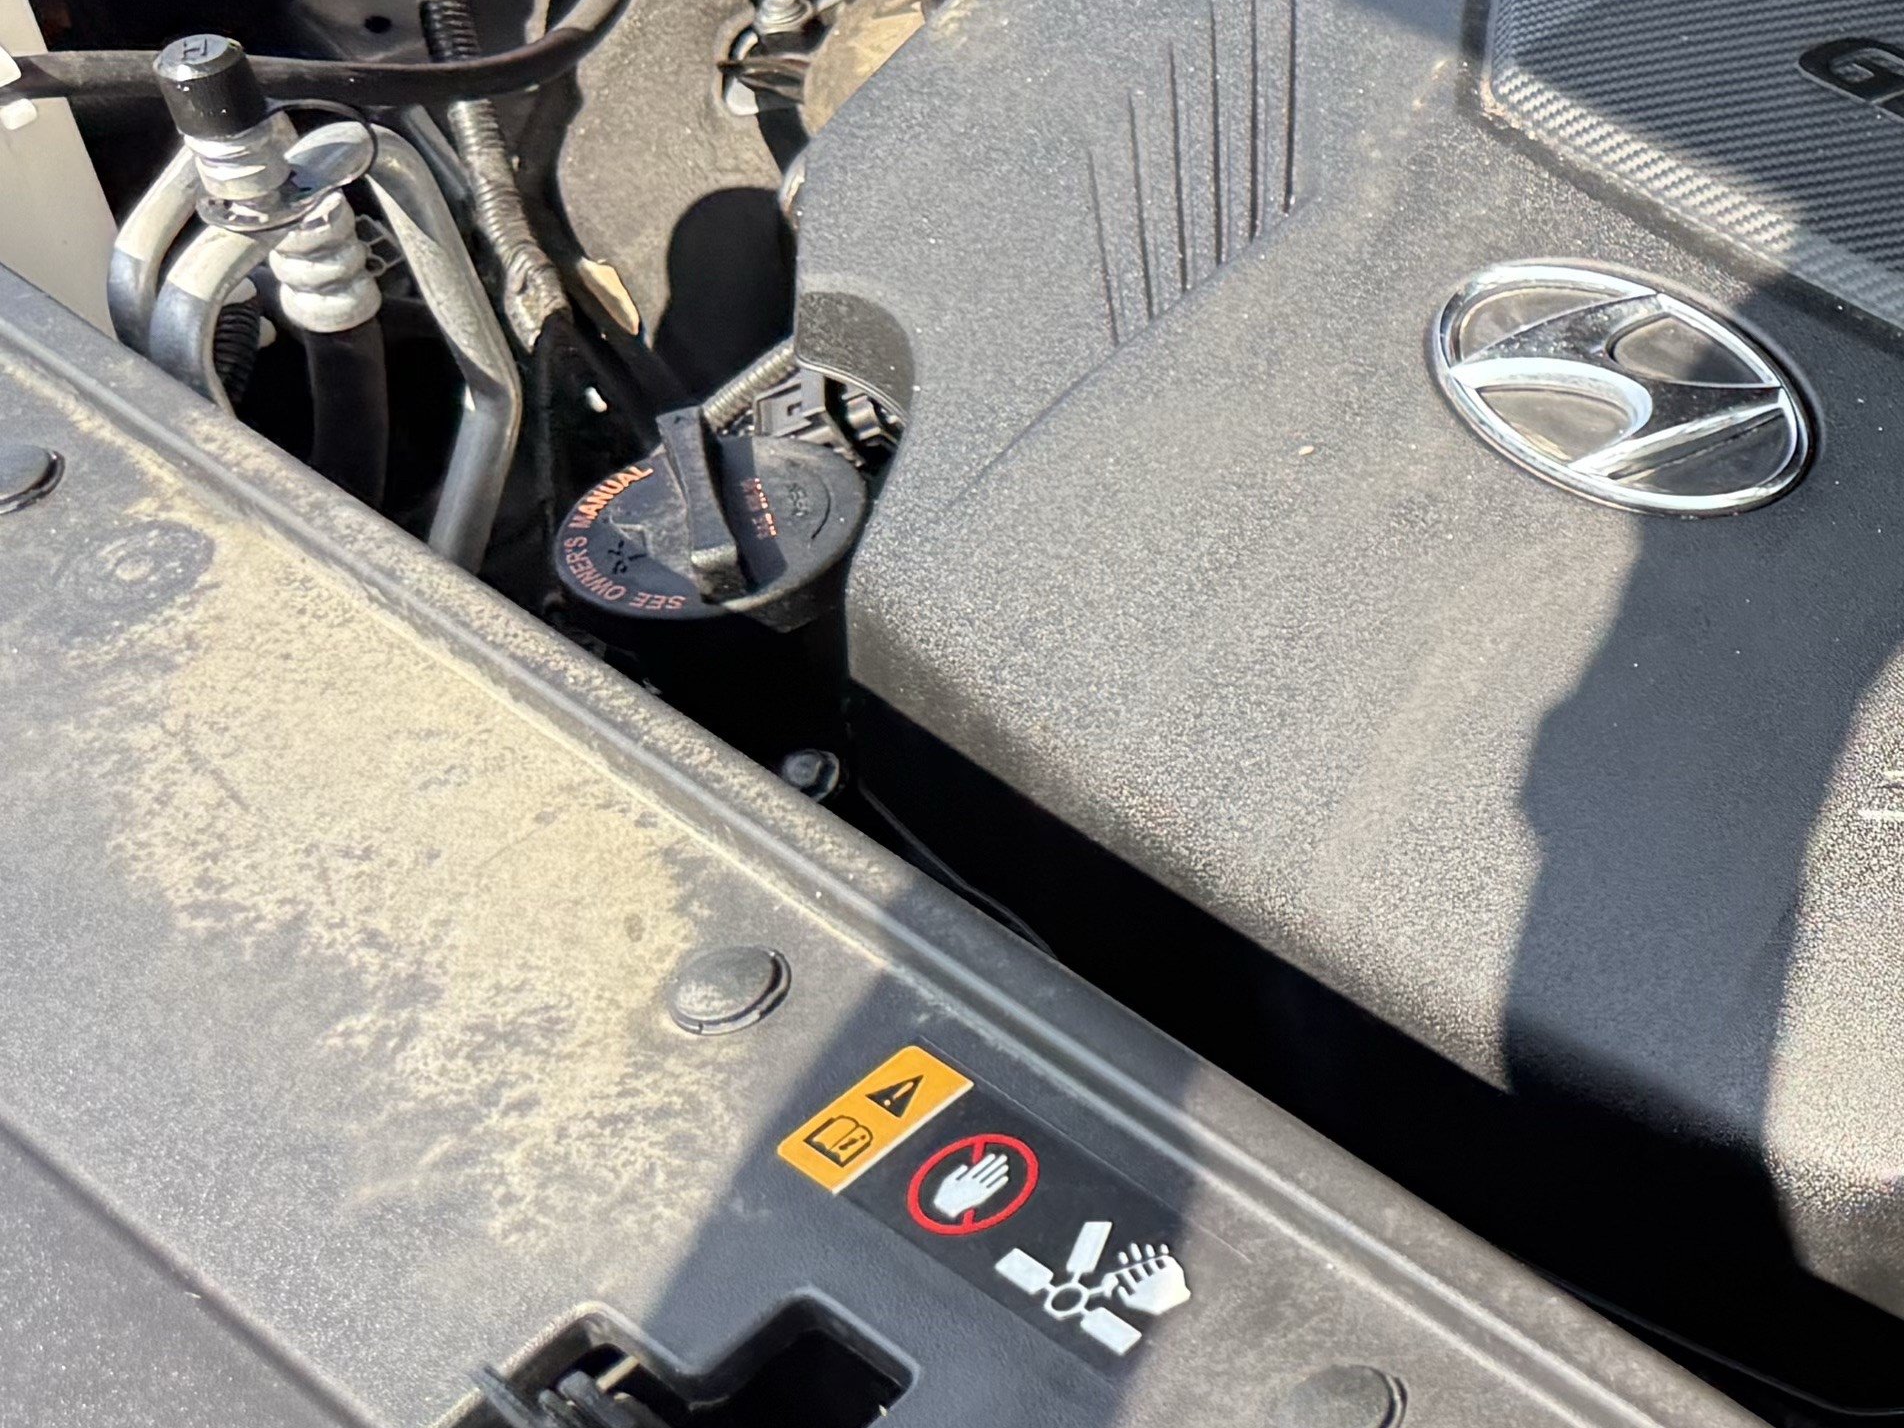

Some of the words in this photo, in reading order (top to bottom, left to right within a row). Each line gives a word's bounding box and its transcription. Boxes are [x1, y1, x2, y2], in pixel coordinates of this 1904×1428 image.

[567, 465, 655, 530] MANUAL
[563, 535, 628, 602] OWNER'S
[629, 591, 687, 610] SEE
